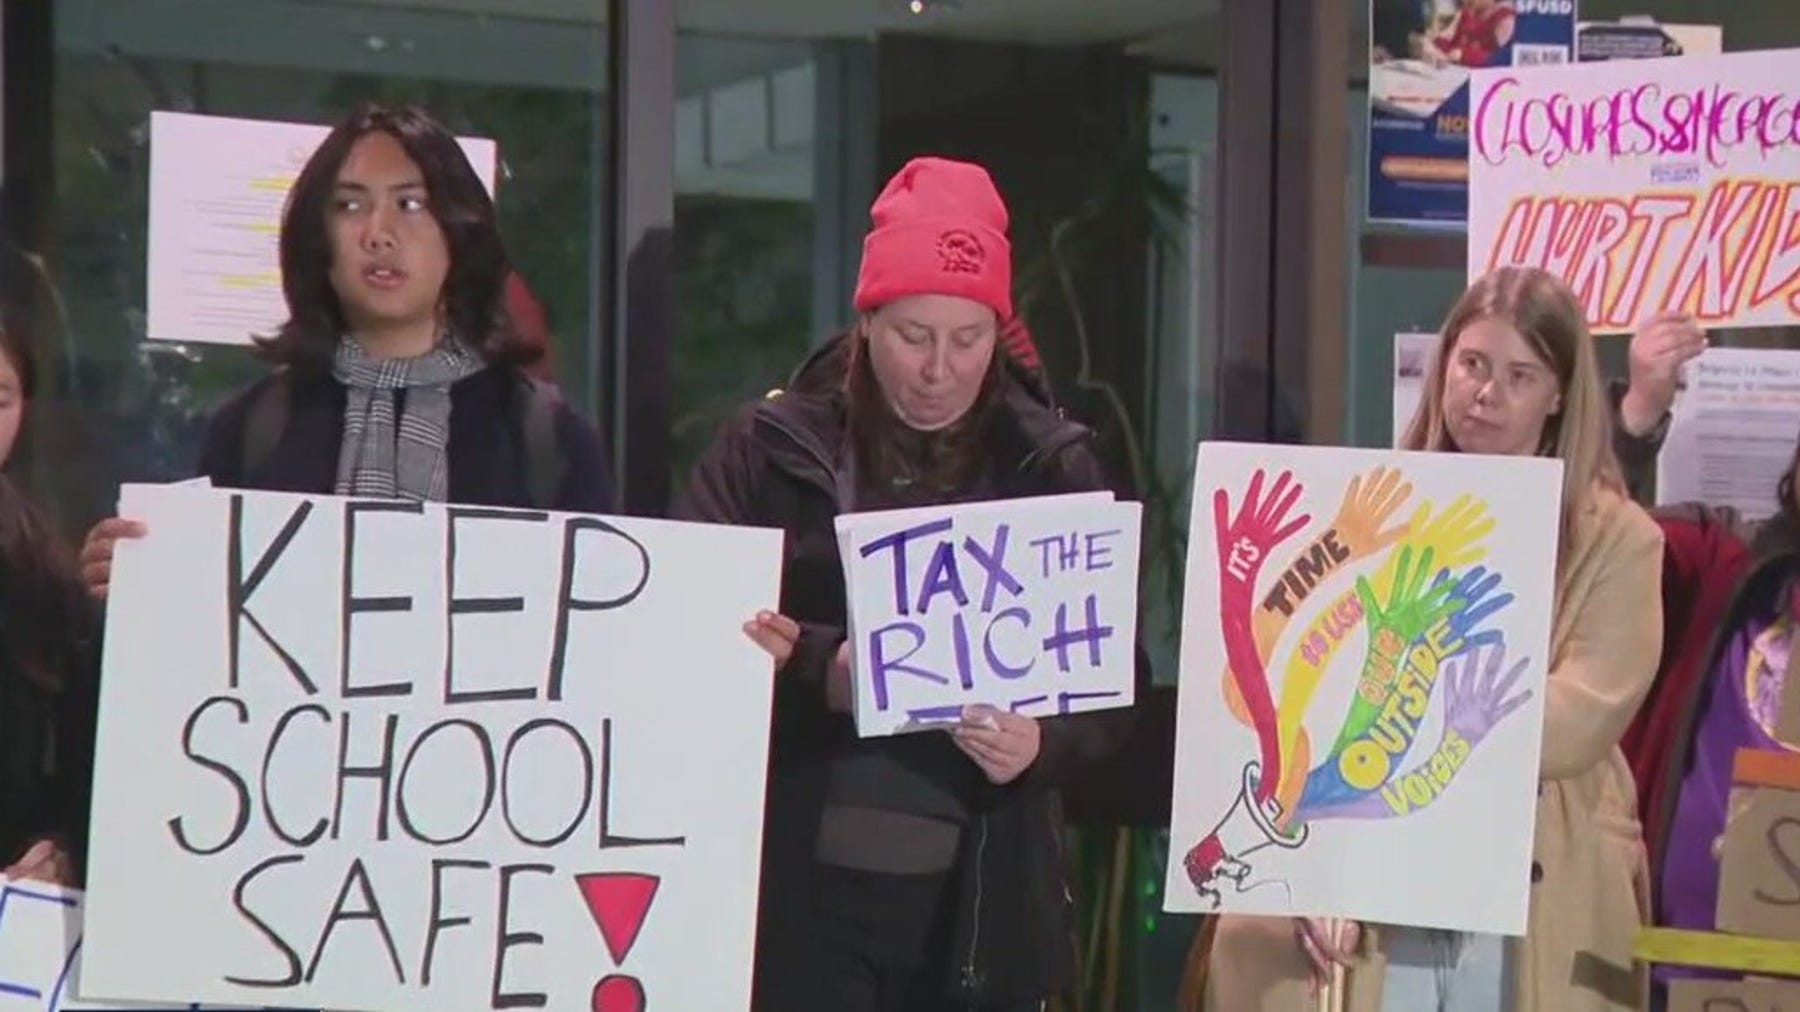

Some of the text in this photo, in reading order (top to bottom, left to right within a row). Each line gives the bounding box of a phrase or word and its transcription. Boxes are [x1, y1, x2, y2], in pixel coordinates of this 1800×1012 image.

[1516, 0, 1572, 14] SFUSD
[1474, 78, 1660, 168] CLOSURES
[1488, 180, 1800, 328] HURT KID
[224, 493, 650, 703] KEEP
[859, 517, 1122, 616] TAX THE
[1263, 529, 1351, 618] TIME
[869, 594, 1114, 711] RICH
[1338, 616, 1467, 790] OUTSIDE
[168, 696, 686, 855] SCHOOL
[224, 854, 660, 1012] SAFE!
